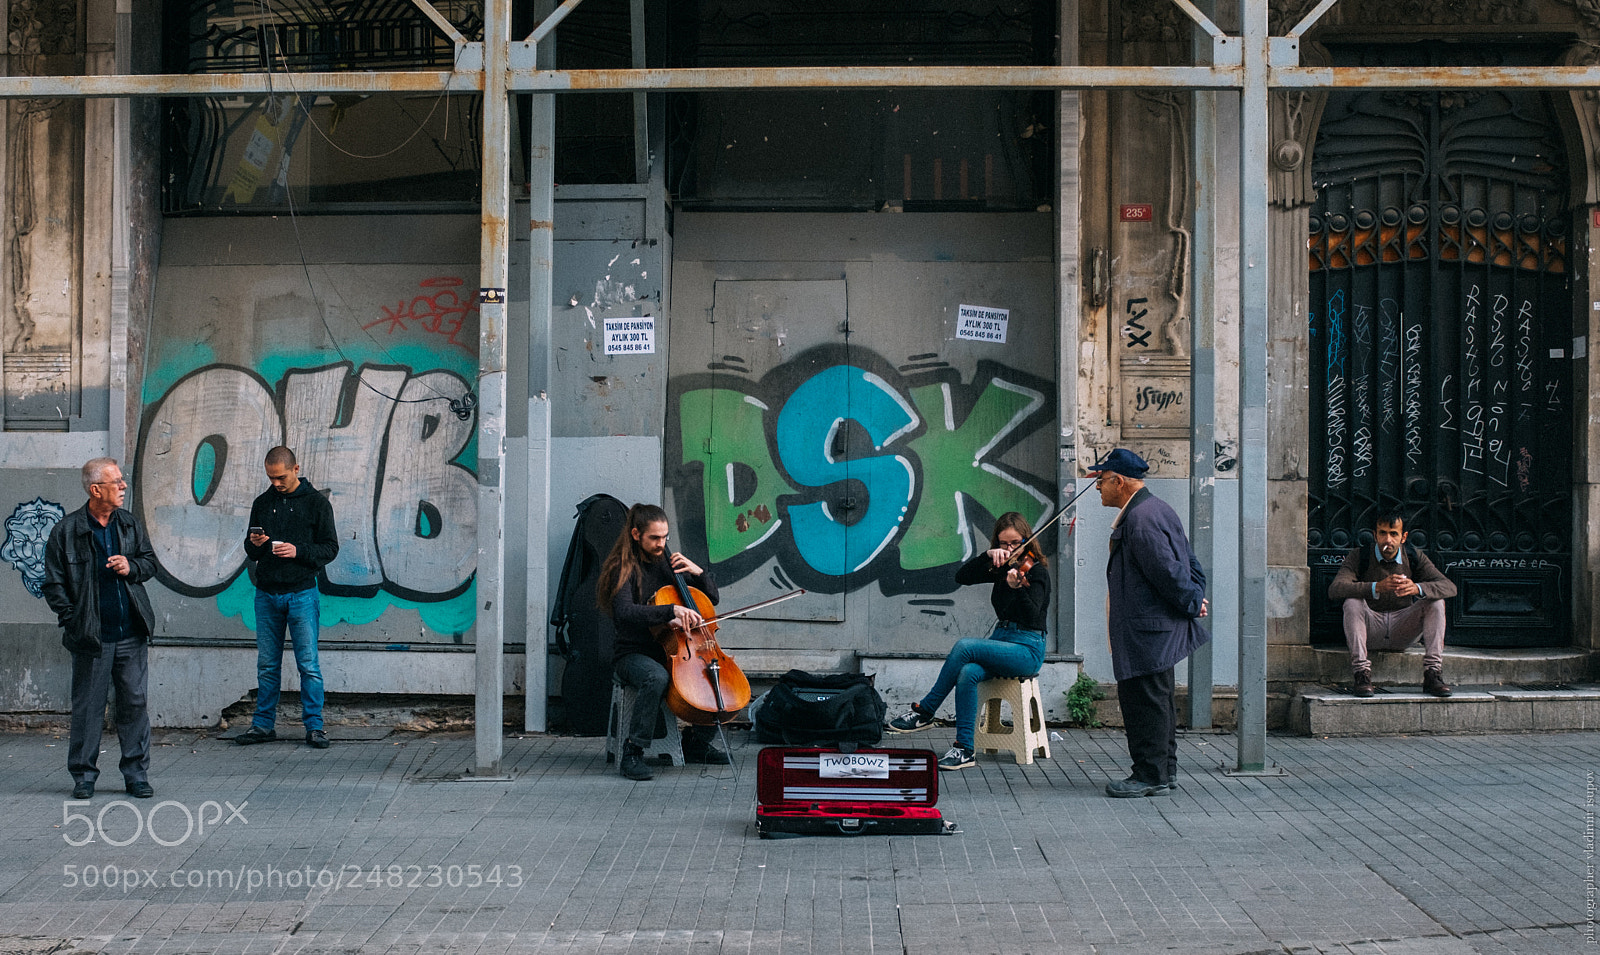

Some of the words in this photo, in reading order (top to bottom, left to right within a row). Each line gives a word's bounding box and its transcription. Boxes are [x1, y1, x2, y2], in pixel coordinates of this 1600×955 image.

[978, 310, 984, 318] DE
[624, 322, 630, 330] DE
[964, 320, 982, 328] AYLIK
[982, 322, 992, 330] 300
[994, 322, 1000, 330] TL
[612, 334, 628, 342] AYLIK
[630, 332, 640, 342] 300
[640, 332, 648, 340] TL
[670, 356, 1055, 595] DSK
[823, 756, 885, 768] TWOBOWZ
